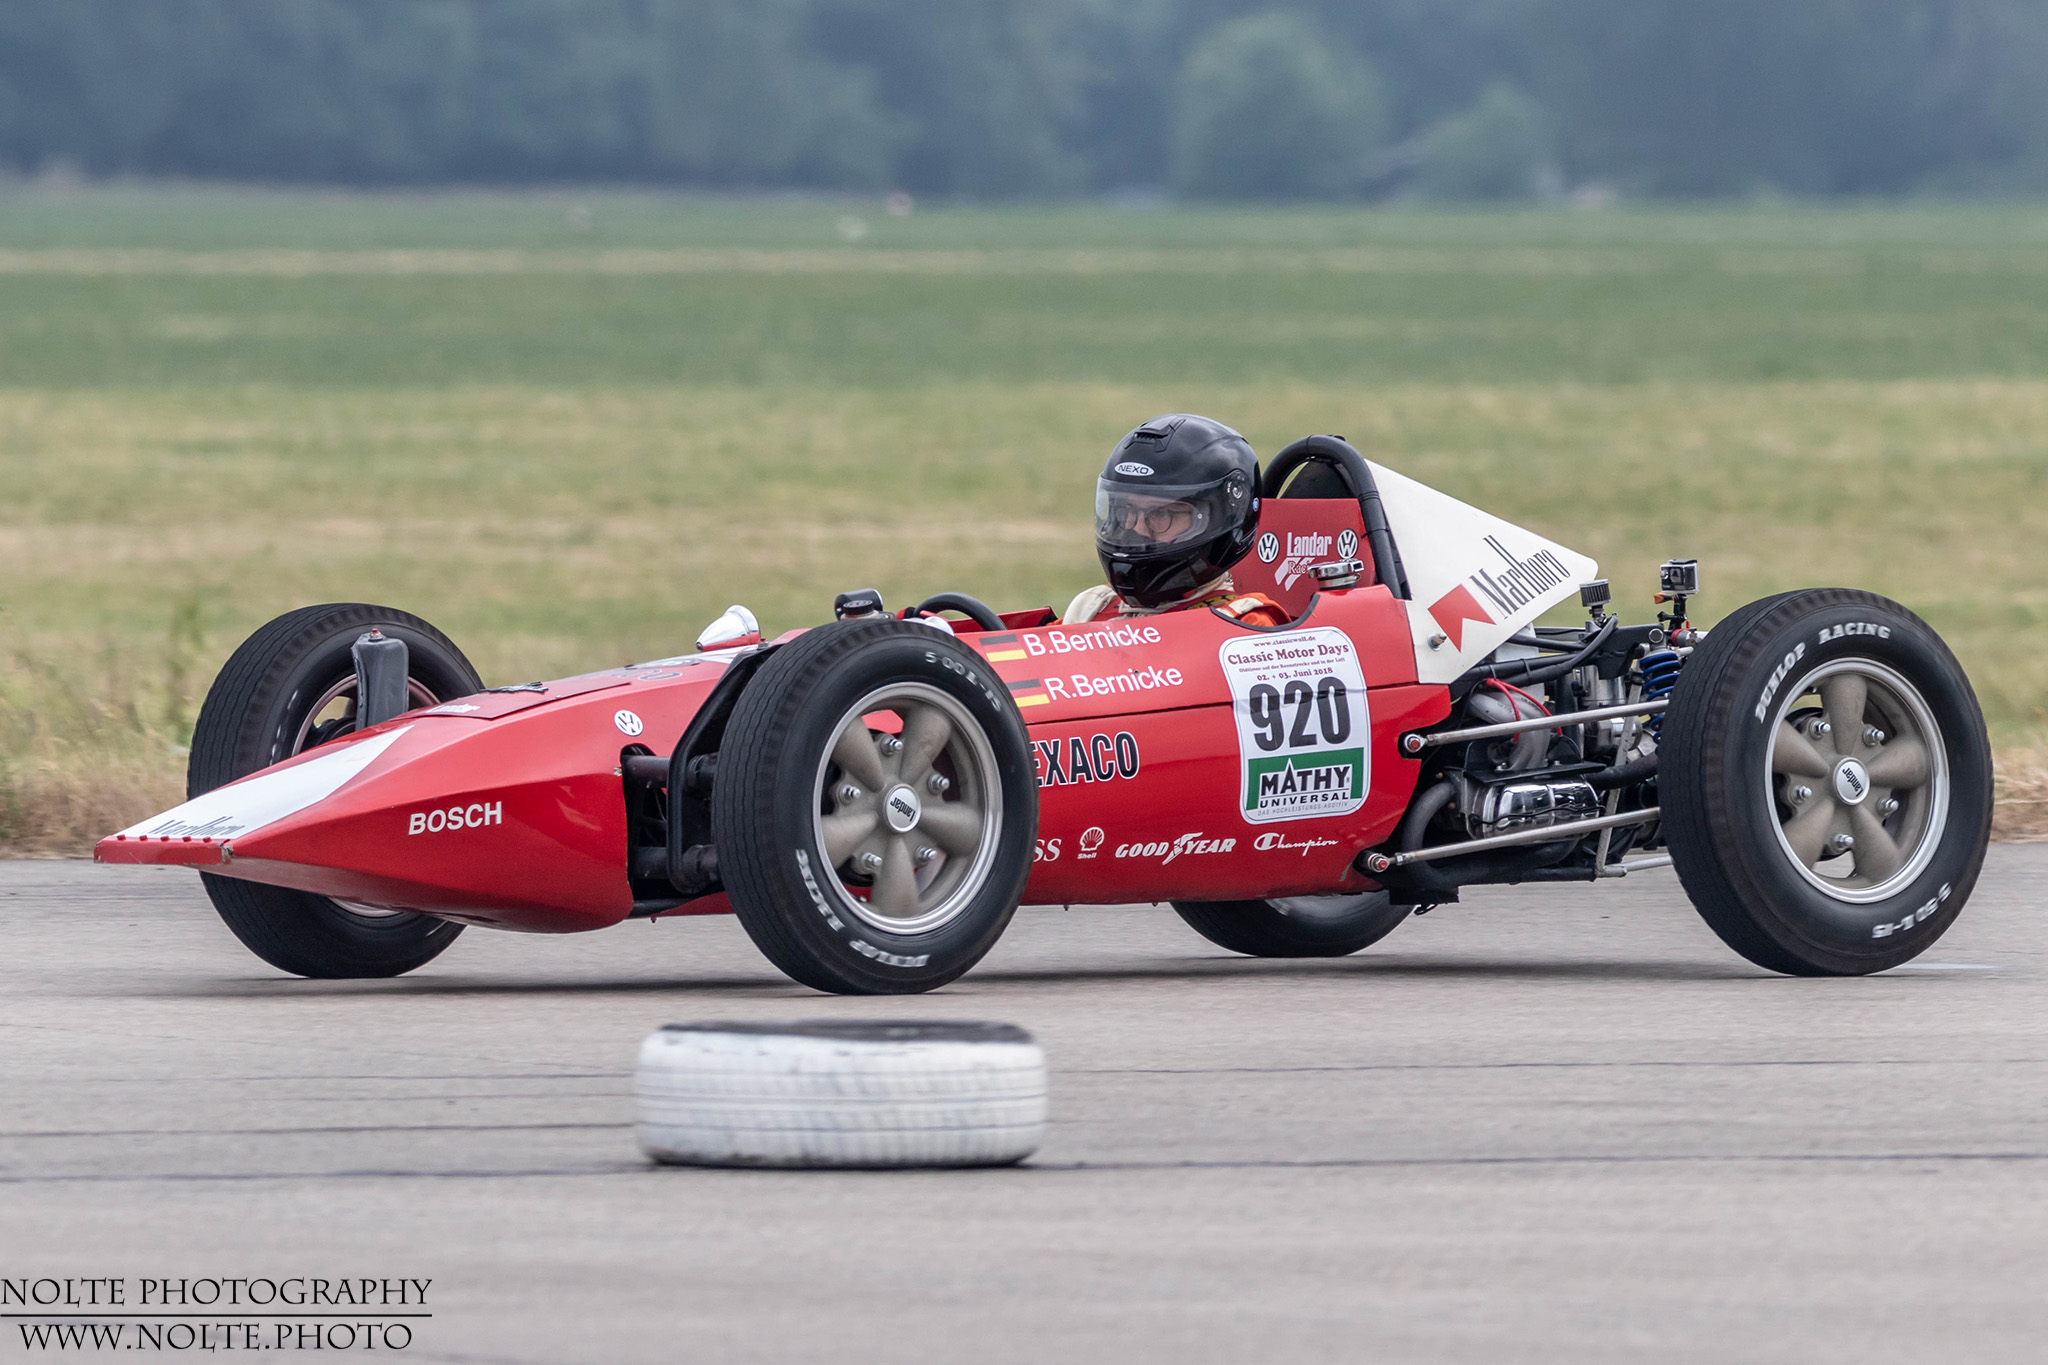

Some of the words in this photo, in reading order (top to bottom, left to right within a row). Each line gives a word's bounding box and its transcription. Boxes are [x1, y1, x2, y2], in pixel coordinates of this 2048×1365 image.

[1118, 464, 1149, 475] NEXO
[1286, 531, 1332, 556] Landar
[1287, 559, 1310, 575] Rac
[1469, 534, 1571, 620] Marlboro
[1227, 651, 1274, 665] Classic
[1275, 648, 1315, 660] Motor
[1317, 644, 1349, 656] Days
[1278, 671, 1291, 679] 03.
[1293, 668, 1312, 677] Juni
[1313, 667, 1334, 676] 2018
[1755, 641, 1806, 724] DUNLOP
[1818, 622, 1891, 645] RACING
[1249, 676, 1352, 752] 920
[1260, 764, 1350, 796] MATHY
[1841, 767, 1864, 797] Landar
[890, 797, 916, 822] Landar
[1260, 792, 1349, 808] UNIVERSAL
[408, 801, 502, 835] BOSCH
[1077, 852, 1097, 860] Shell
[1253, 832, 1339, 857] Champion
